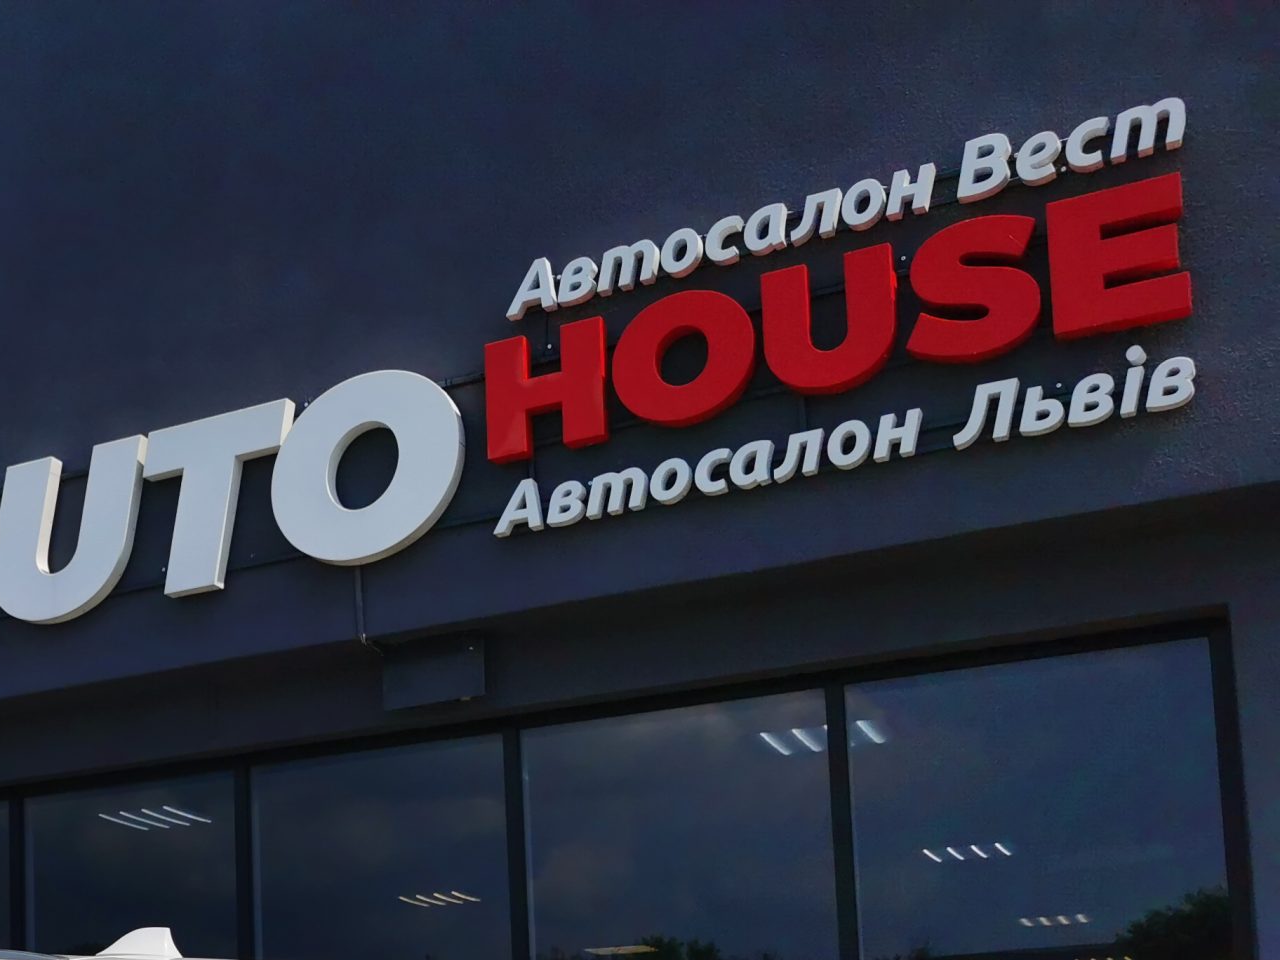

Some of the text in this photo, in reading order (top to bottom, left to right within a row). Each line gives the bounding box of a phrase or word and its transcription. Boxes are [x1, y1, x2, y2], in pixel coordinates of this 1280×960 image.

[484, 171, 1193, 465] HOUSE
[506, 96, 1186, 321] Автосалон Вест
[492, 345, 1196, 539] Автосалон Львів
